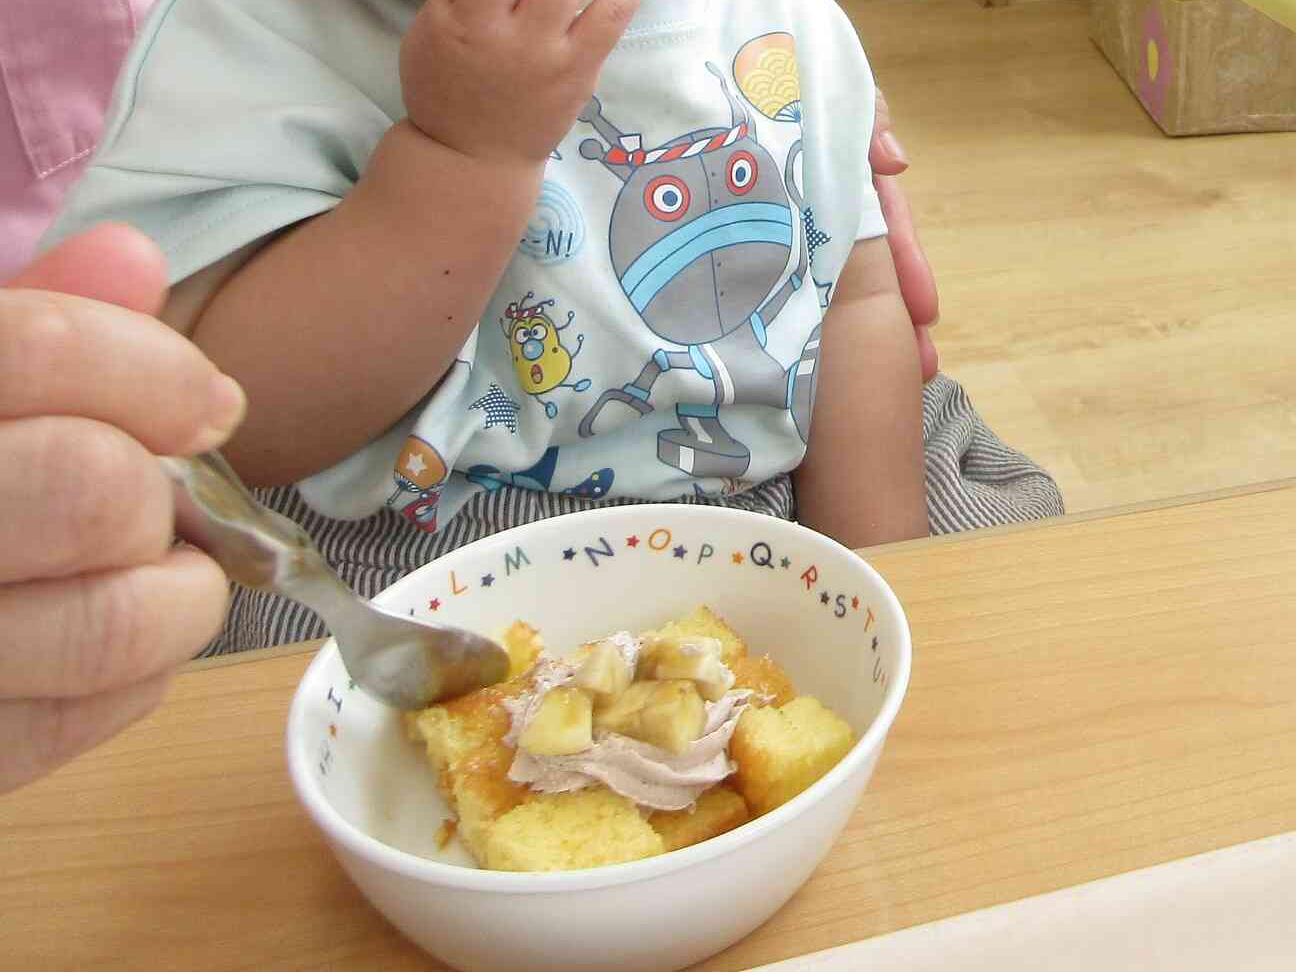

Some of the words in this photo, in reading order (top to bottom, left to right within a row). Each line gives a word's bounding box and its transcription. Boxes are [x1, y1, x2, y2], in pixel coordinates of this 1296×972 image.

[327, 686, 343, 714] I
[450, 570, 468, 596] L
[504, 545, 532, 576] M
[584, 536, 615, 567] N
[647, 527, 673, 551] O
[696, 543, 714, 565] P
[750, 541, 775, 569] Q
[800, 564, 819, 590] R
[834, 594, 847, 618] S
